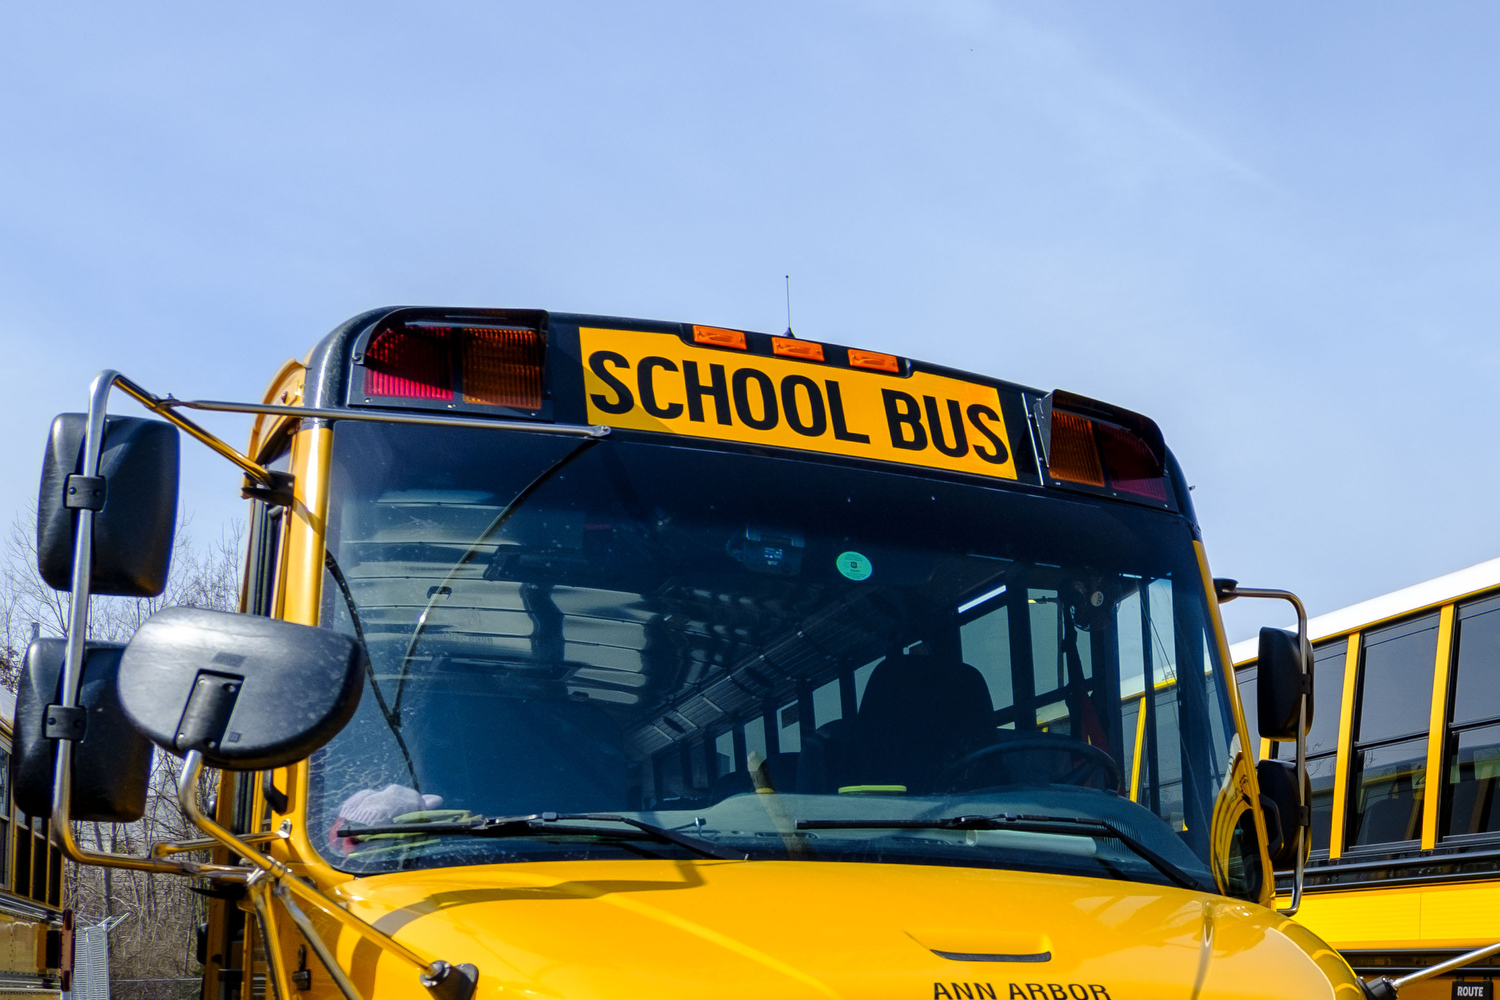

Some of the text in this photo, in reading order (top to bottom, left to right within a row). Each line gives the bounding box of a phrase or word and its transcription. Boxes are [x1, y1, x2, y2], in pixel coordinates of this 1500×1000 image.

[588, 349, 1009, 465] SCHOOL BUS
[934, 982, 998, 1000] ANN
[1457, 986, 1484, 997] ROUTE
